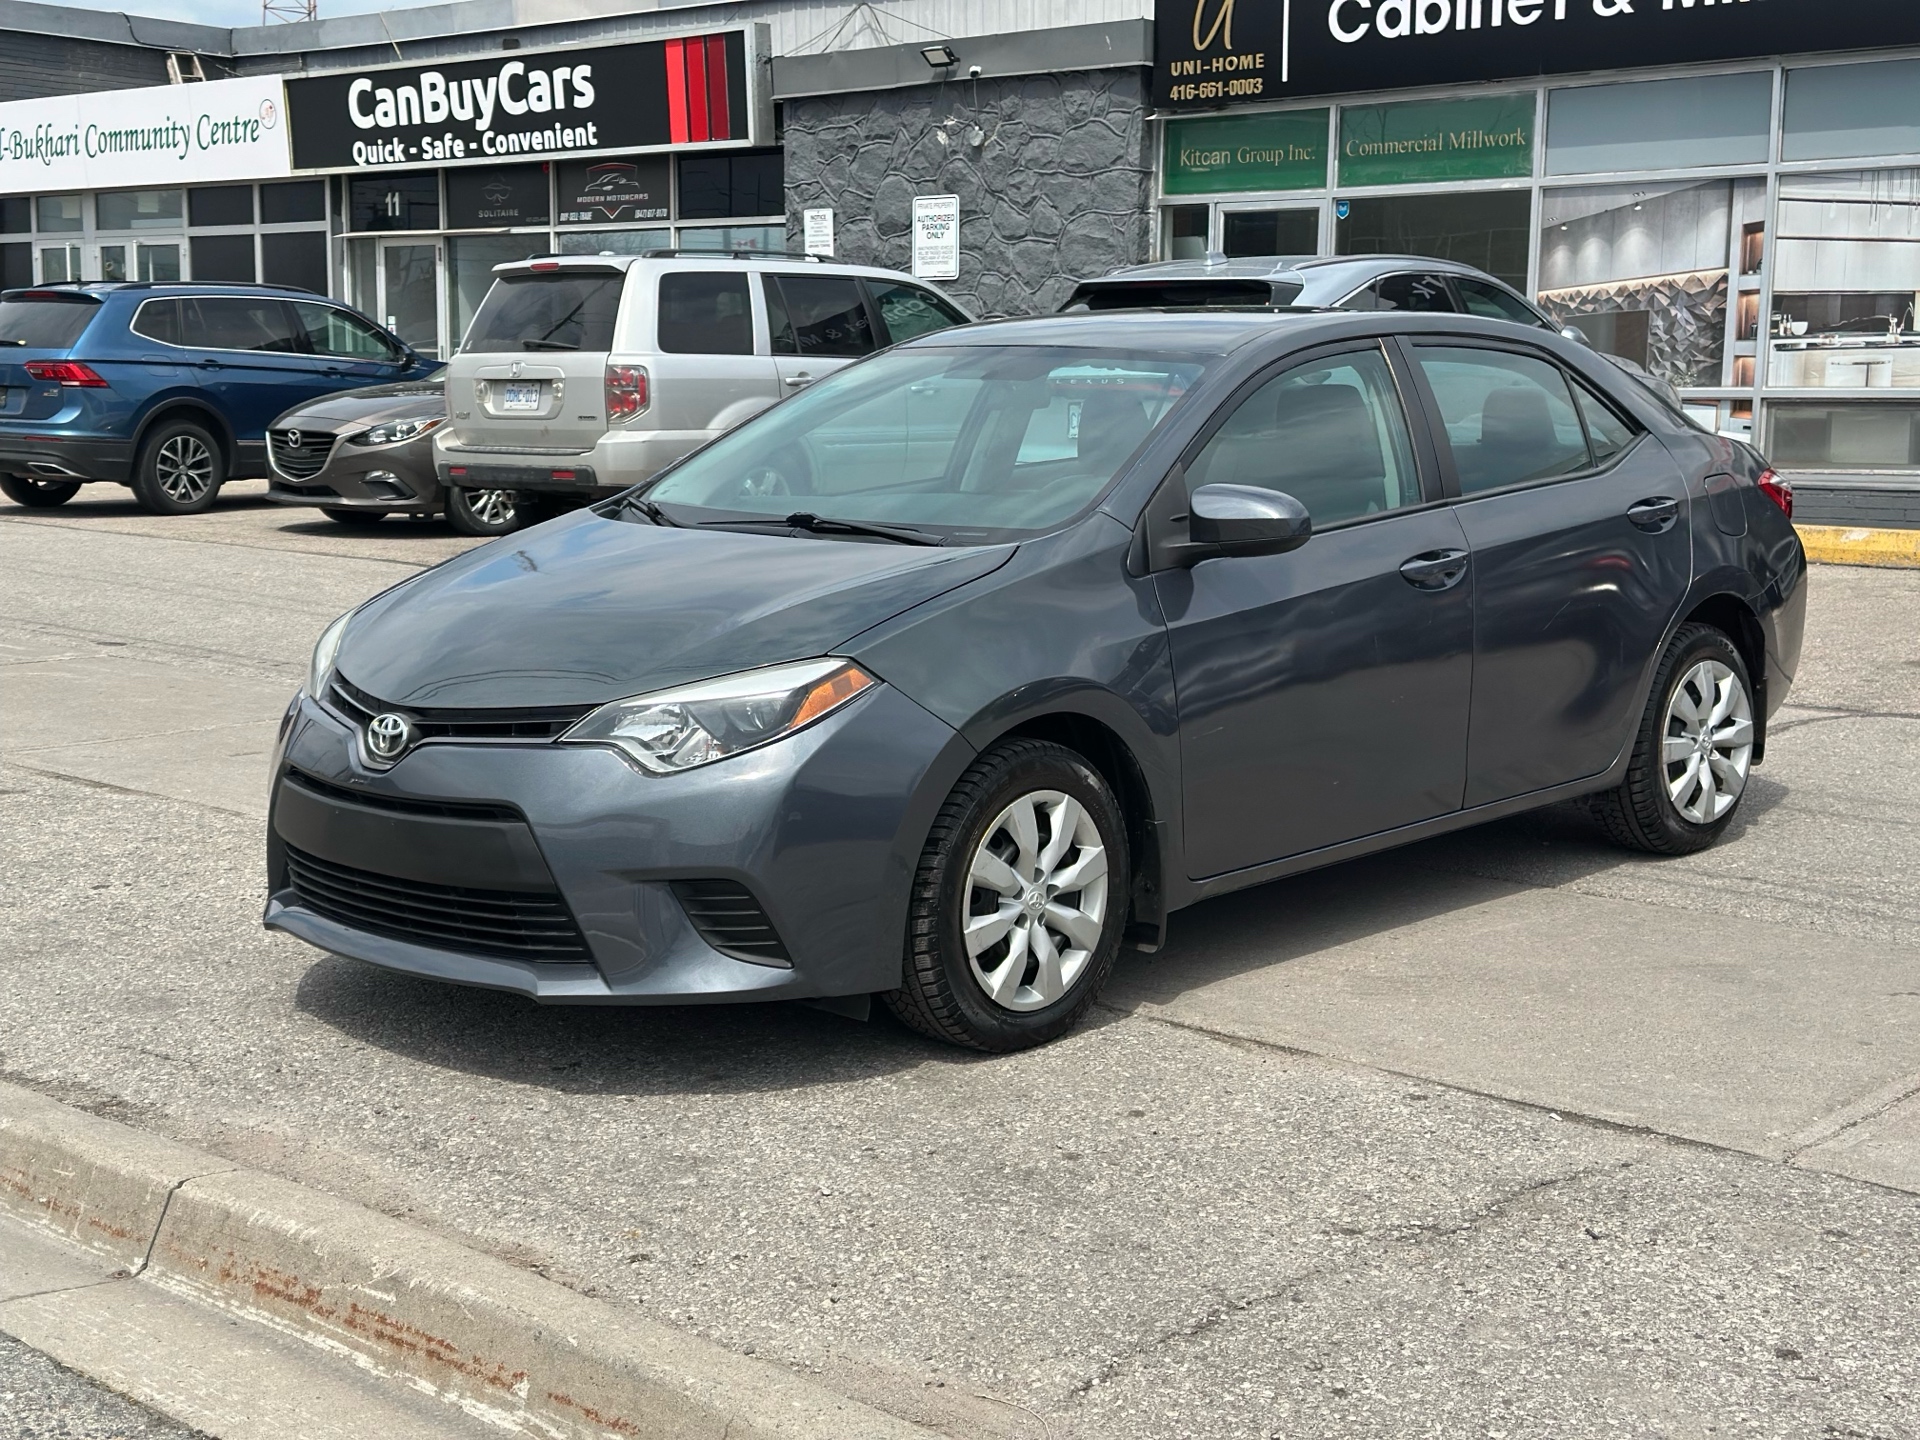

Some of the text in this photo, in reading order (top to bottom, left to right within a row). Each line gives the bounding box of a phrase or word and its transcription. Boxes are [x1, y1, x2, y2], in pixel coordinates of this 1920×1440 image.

[1170, 53, 1265, 77] UNI-HOME
[348, 60, 596, 131] CanBuyCars
[1169, 78, 1264, 101] 416-661-0003
[85, 115, 191, 161] Community
[196, 114, 260, 151] Centre
[353, 137, 406, 166] Quick
[421, 132, 465, 160] Safe
[482, 121, 599, 155] Convenient
[1346, 127, 1527, 157] Commercial Millwork
[1180, 144, 1316, 167] Kitcan Group Inc.
[384, 192, 401, 217] 11
[577, 193, 648, 203] MODERN MOTORCARS
[478, 208, 520, 218] SOLITAIRE
[917, 213, 955, 223] AUTHORIZED
[921, 222, 950, 231] PARKING
[926, 231, 946, 240] ONLY
